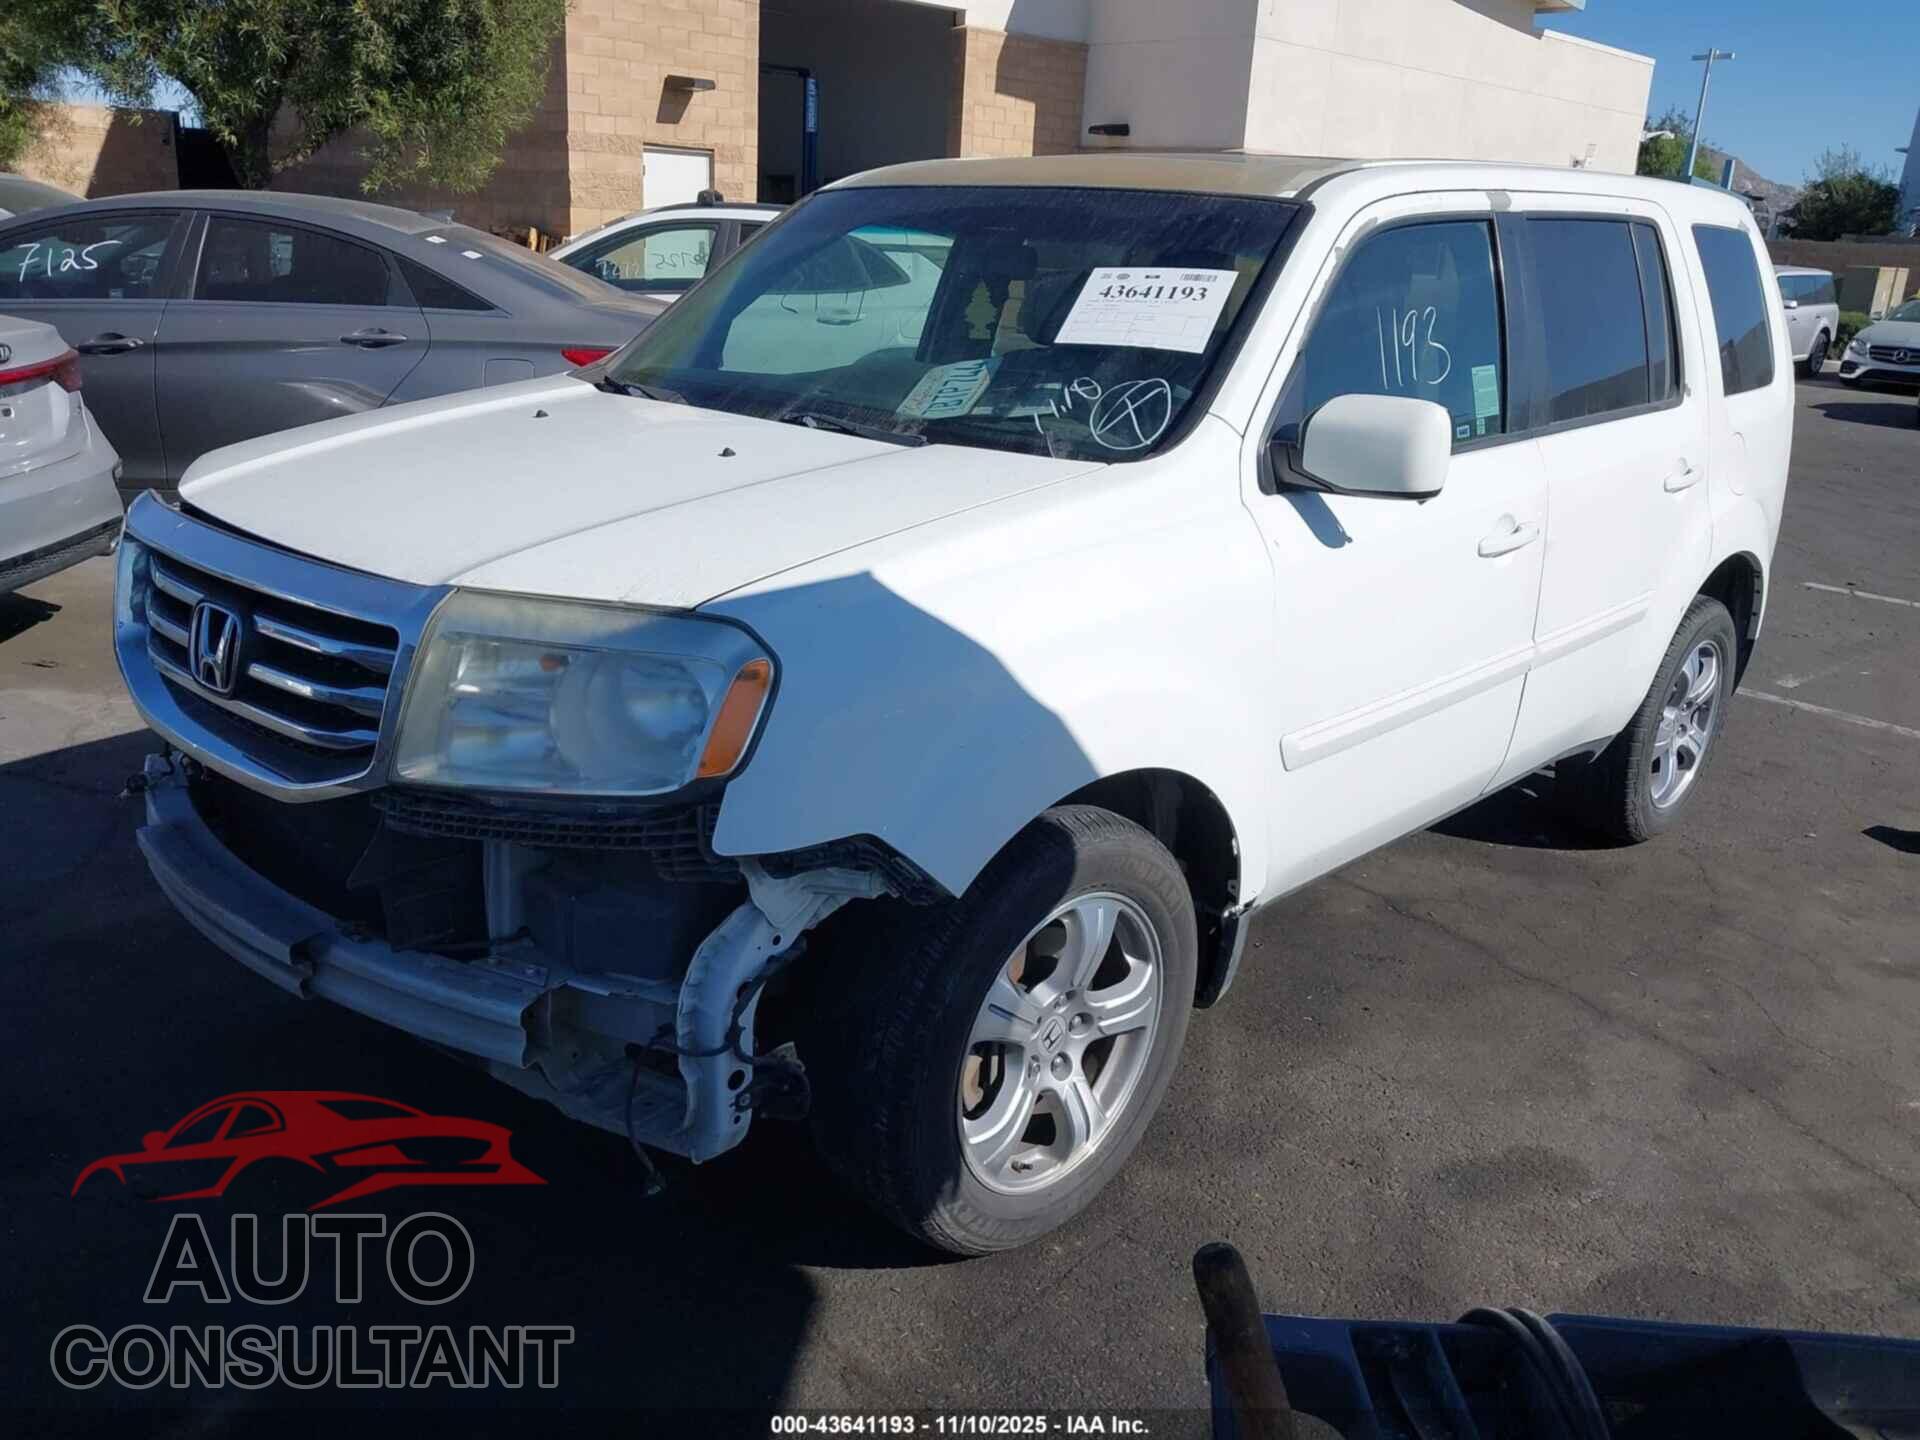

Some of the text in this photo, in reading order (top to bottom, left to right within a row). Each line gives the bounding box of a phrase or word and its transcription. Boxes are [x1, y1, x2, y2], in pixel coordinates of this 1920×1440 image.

[17, 239, 123, 283] 7125
[1099, 284, 1208, 301] 43641193
[1376, 305, 1451, 390] 1193
